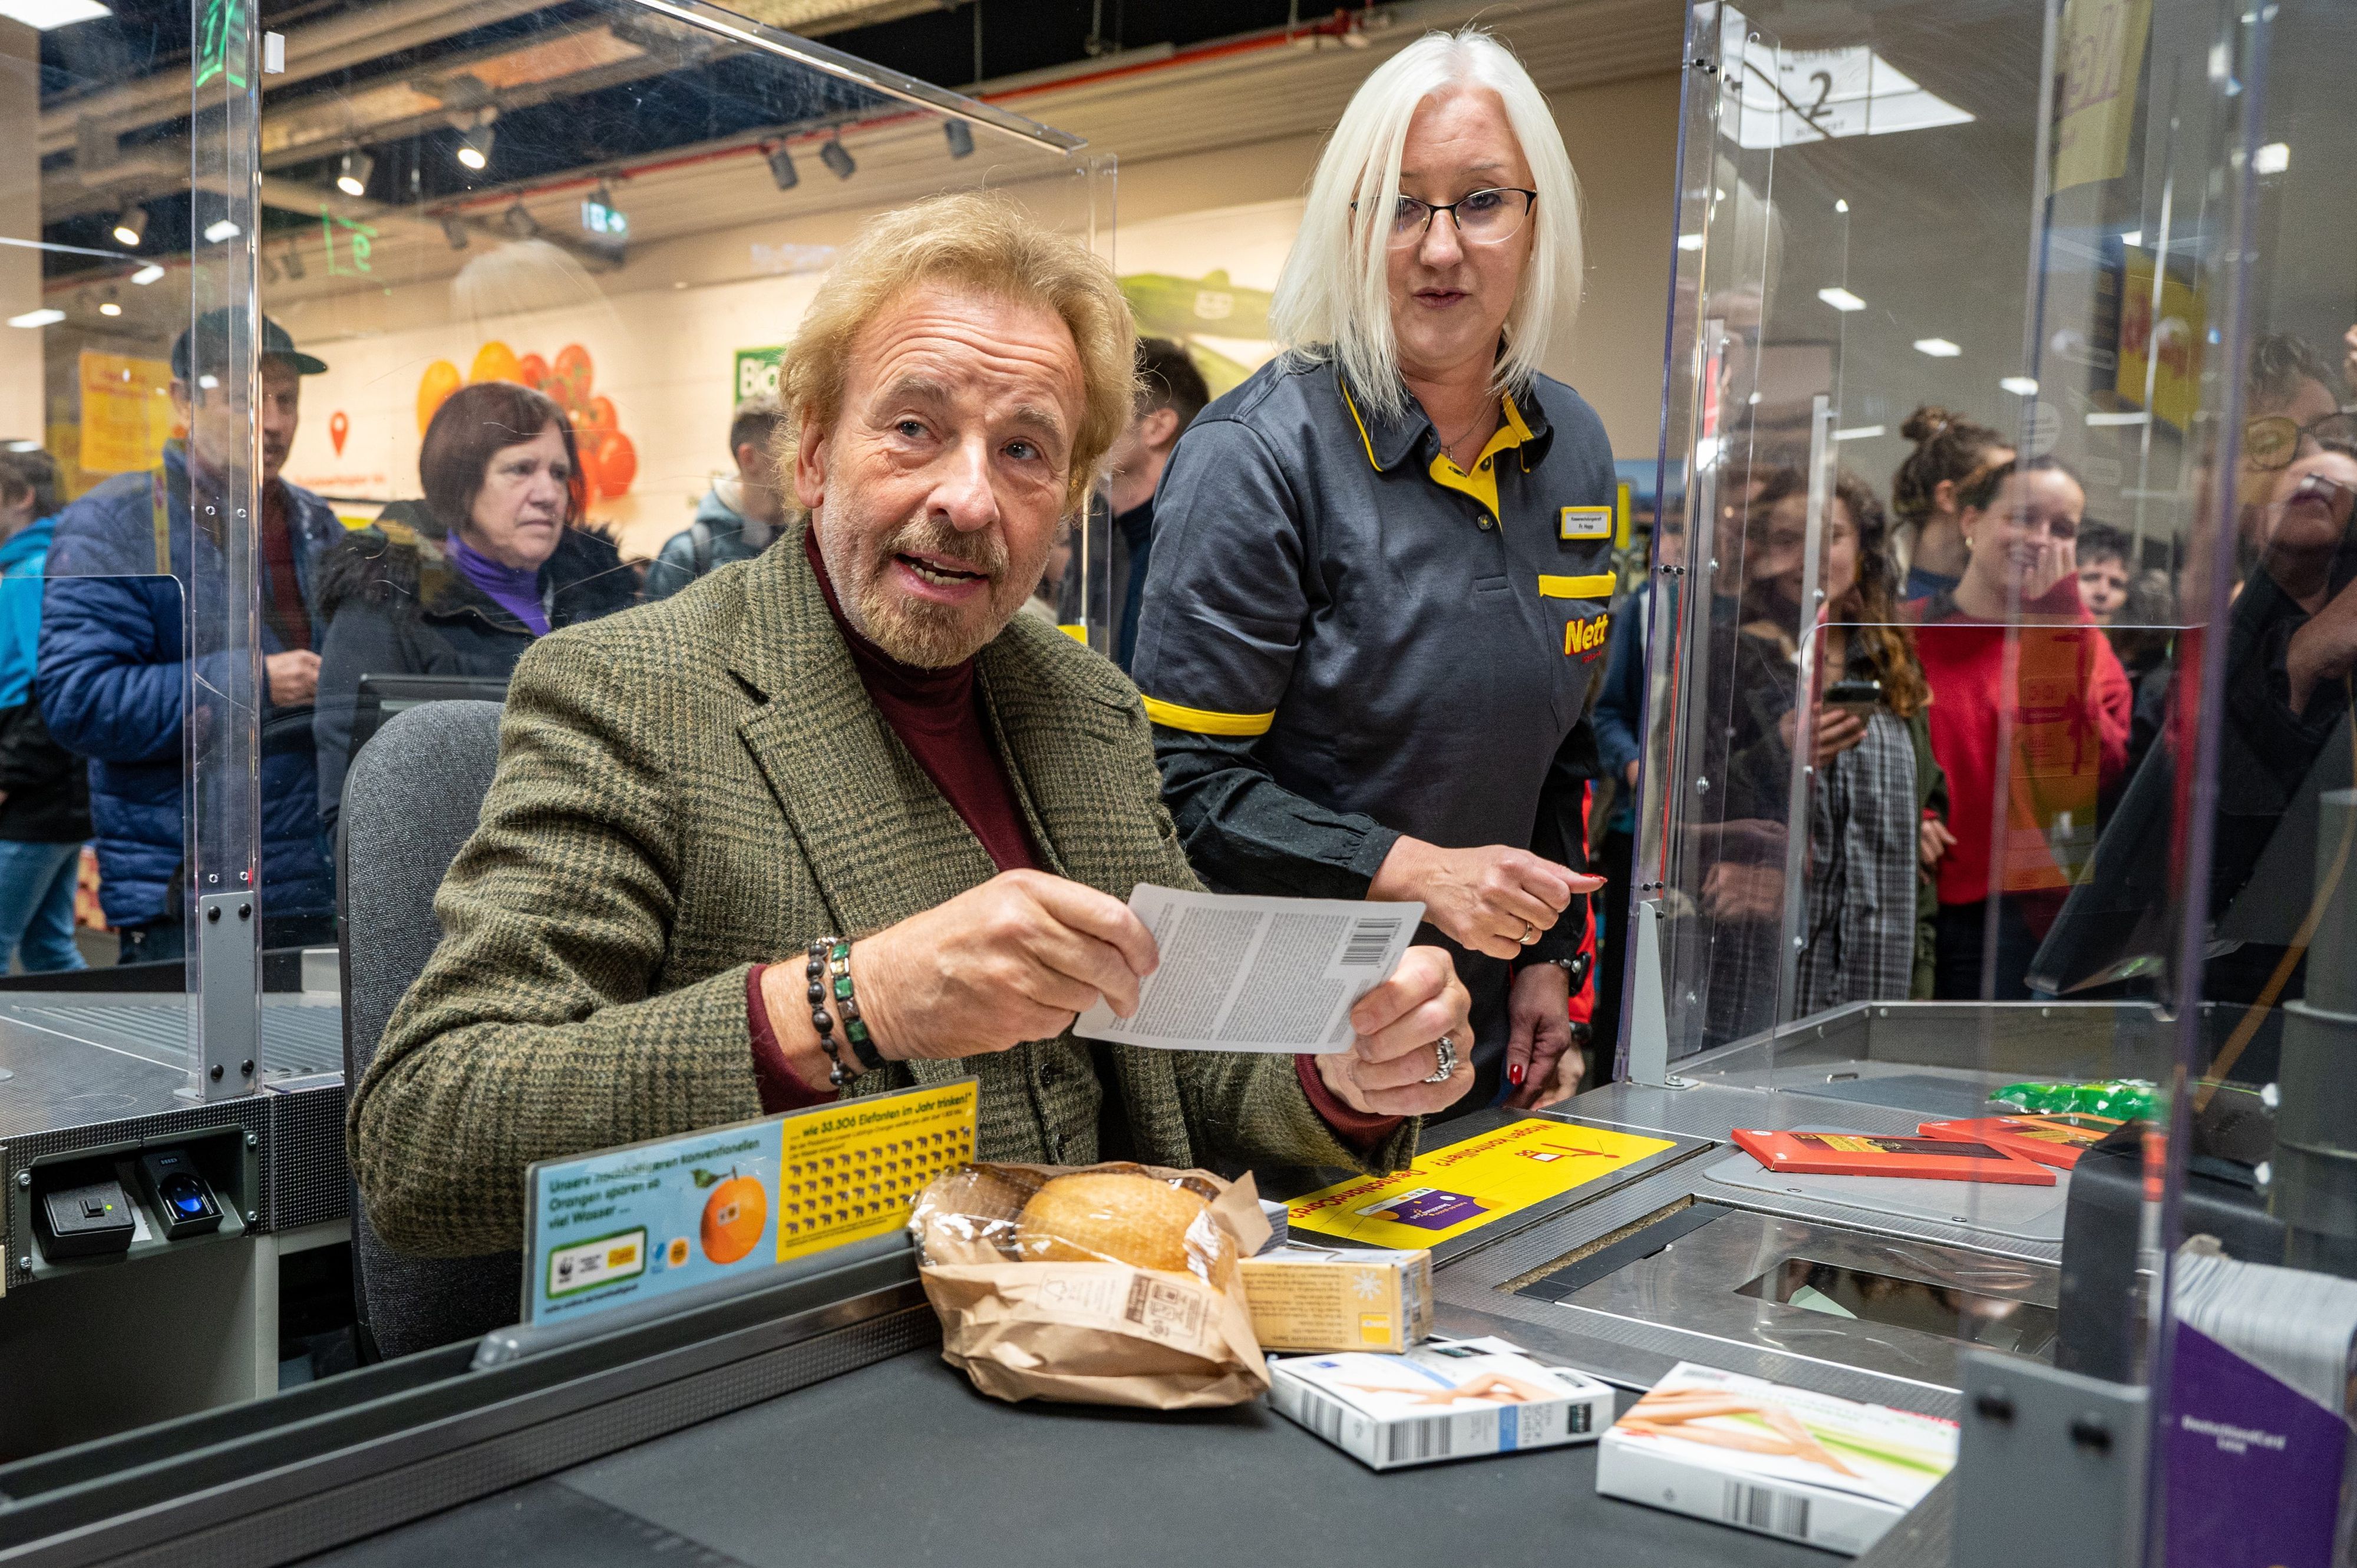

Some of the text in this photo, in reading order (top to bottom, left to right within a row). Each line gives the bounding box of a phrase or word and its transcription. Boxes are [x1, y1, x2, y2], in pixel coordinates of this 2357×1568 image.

[740, 358, 780, 396] Bio
[803, 1126, 819, 1137] wie
[821, 1116, 857, 1133] 33.306
[859, 1107, 900, 1126] Elefanten
[902, 1105, 913, 1117] im
[915, 1100, 935, 1114] Jahr
[1430, 1124, 1558, 1167] Wagen kontrolliert?
[549, 1175, 592, 1193] Unsere
[549, 1190, 602, 1212] Orangen
[605, 1183, 645, 1200] sparen
[572, 1206, 616, 1224] Wasser
